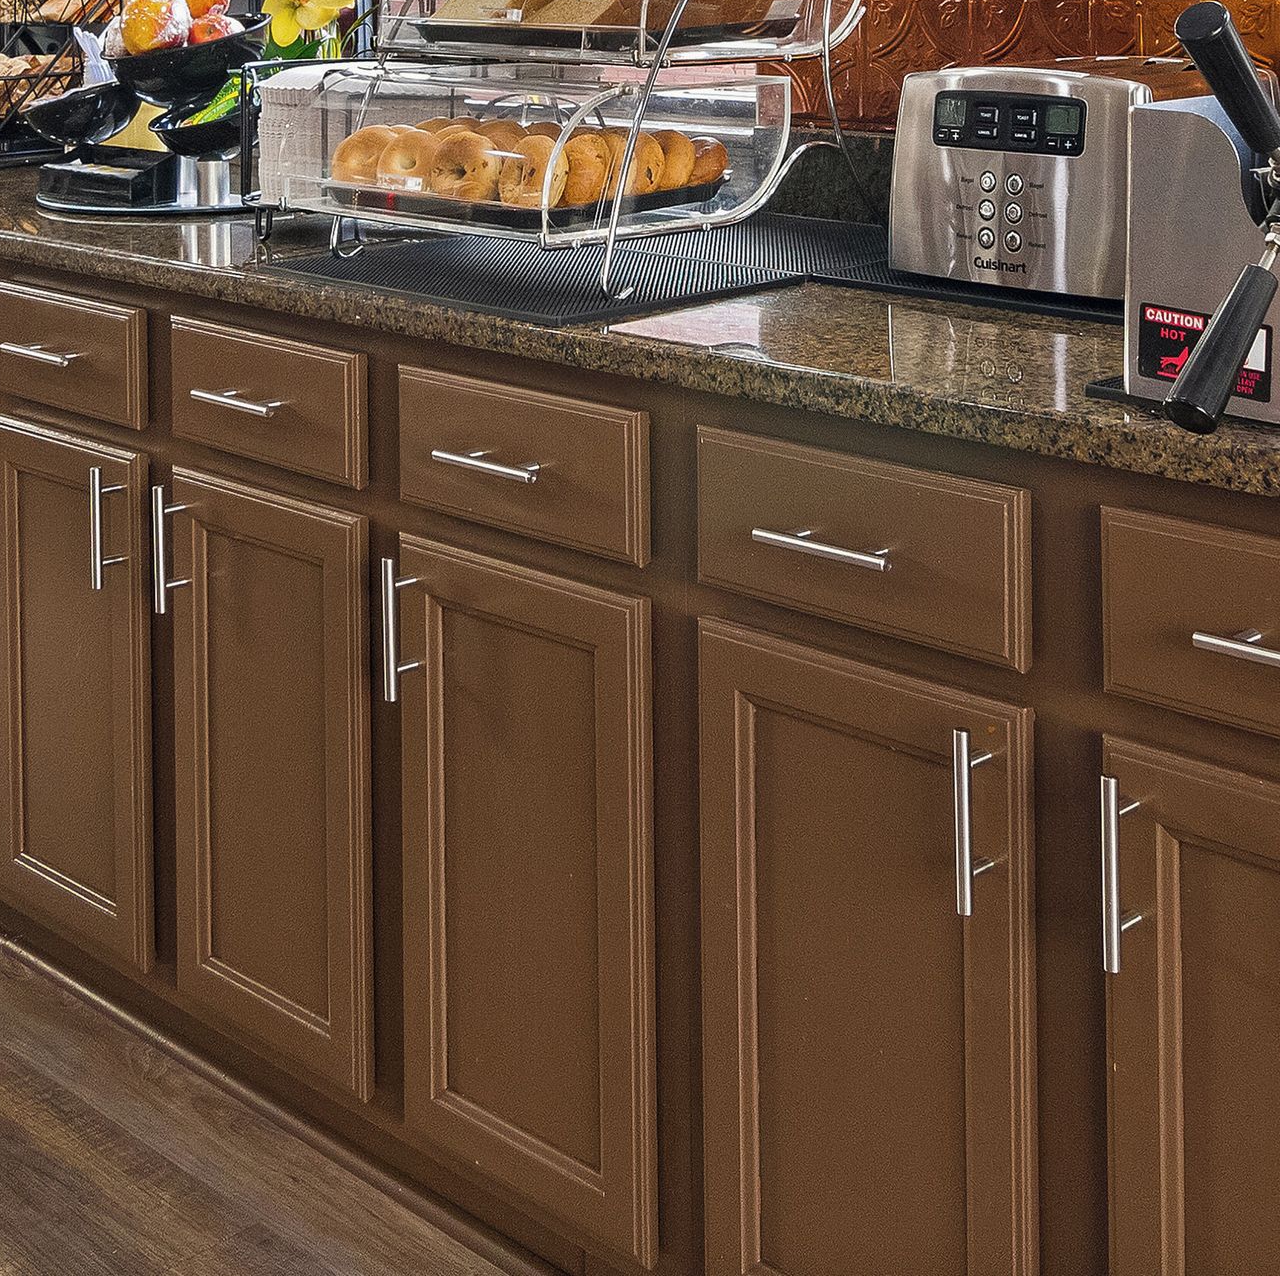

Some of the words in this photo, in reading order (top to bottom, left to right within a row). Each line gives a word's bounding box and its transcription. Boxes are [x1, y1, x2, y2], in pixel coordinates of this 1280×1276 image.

[974, 256, 1027, 274] Cuisinart
[1146, 308, 1204, 329] CAUTION
[1160, 327, 1187, 342] HOT
